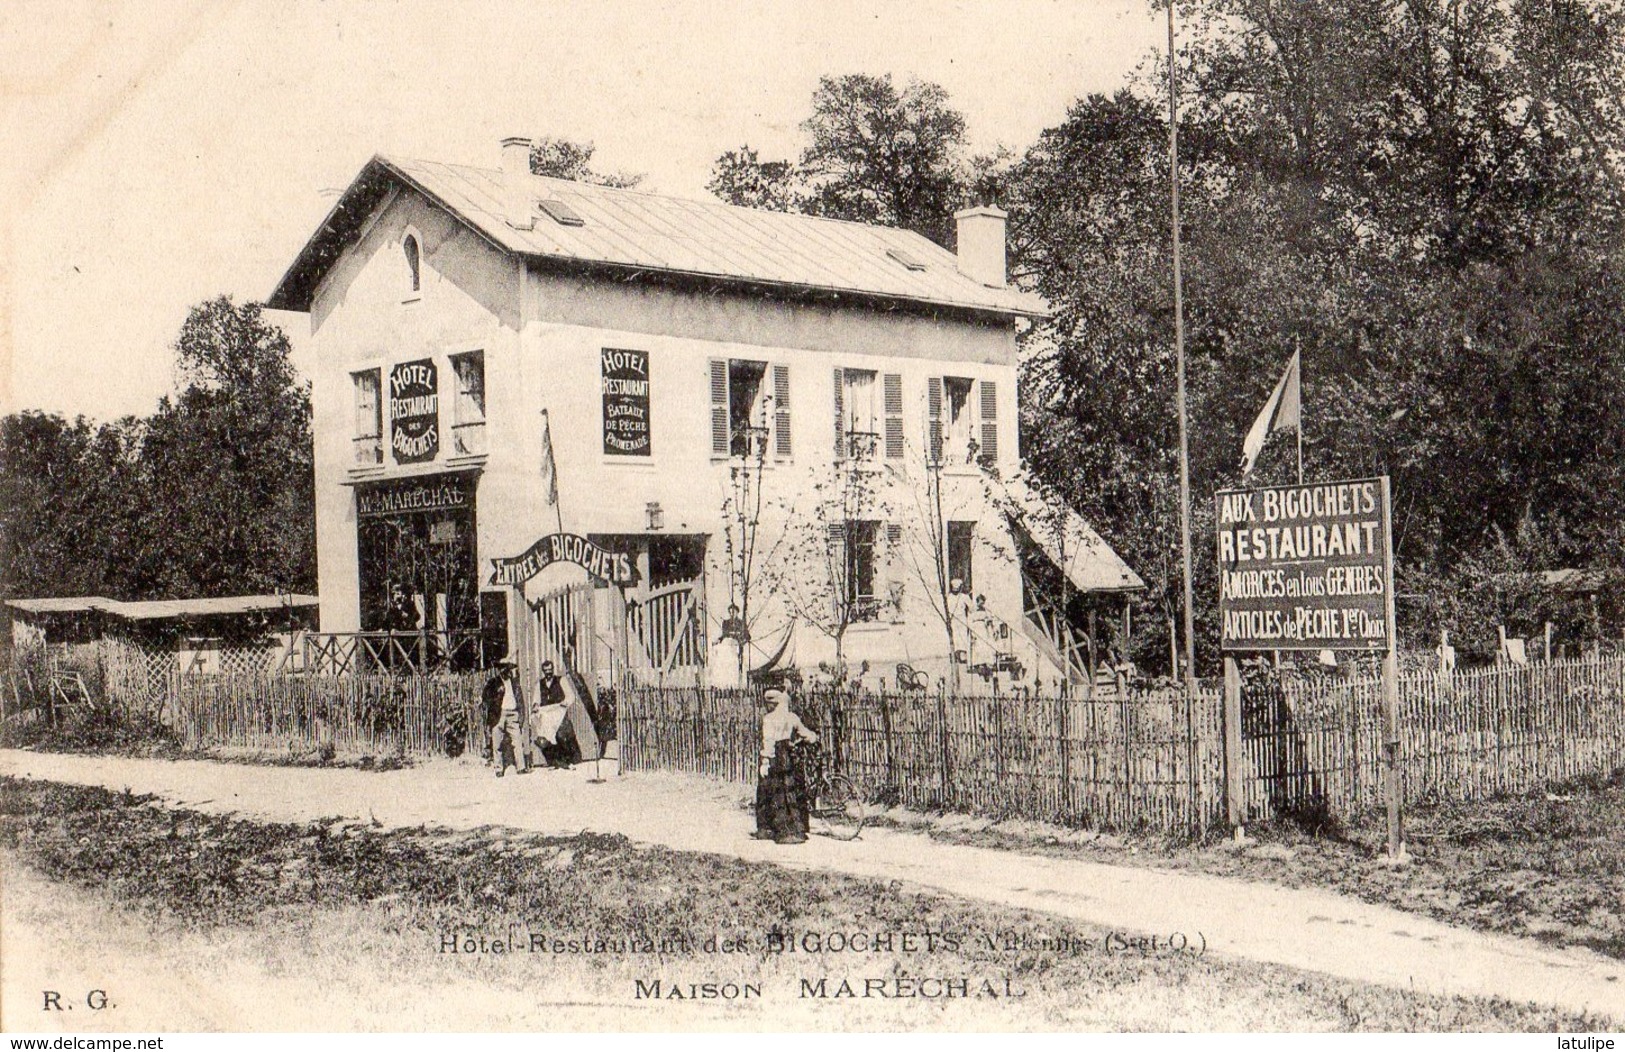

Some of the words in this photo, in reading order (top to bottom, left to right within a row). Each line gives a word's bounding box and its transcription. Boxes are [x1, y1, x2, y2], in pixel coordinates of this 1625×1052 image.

[602, 350, 645, 375] HÔTEL
[391, 364, 433, 397] HÔTEL
[602, 376, 649, 396] RESTAURANT
[391, 394, 438, 420] RESTAURANT
[607, 403, 644, 419] BATEAUX
[605, 420, 617, 430] DE
[1221, 493, 1256, 524] AUX
[1263, 482, 1375, 522] BIGOCHETS
[551, 534, 633, 581] BIGOCHETS
[1220, 520, 1379, 562] RESTAURANT
[1221, 569, 1286, 600] AMORCES
[1286, 578, 1300, 598] en
[1325, 565, 1384, 596] GENRES
[1223, 609, 1283, 641] ARTICLES
[1283, 613, 1297, 639] de
[1294, 605, 1341, 641] PÊCHE
[1359, 609, 1386, 639] Choix
